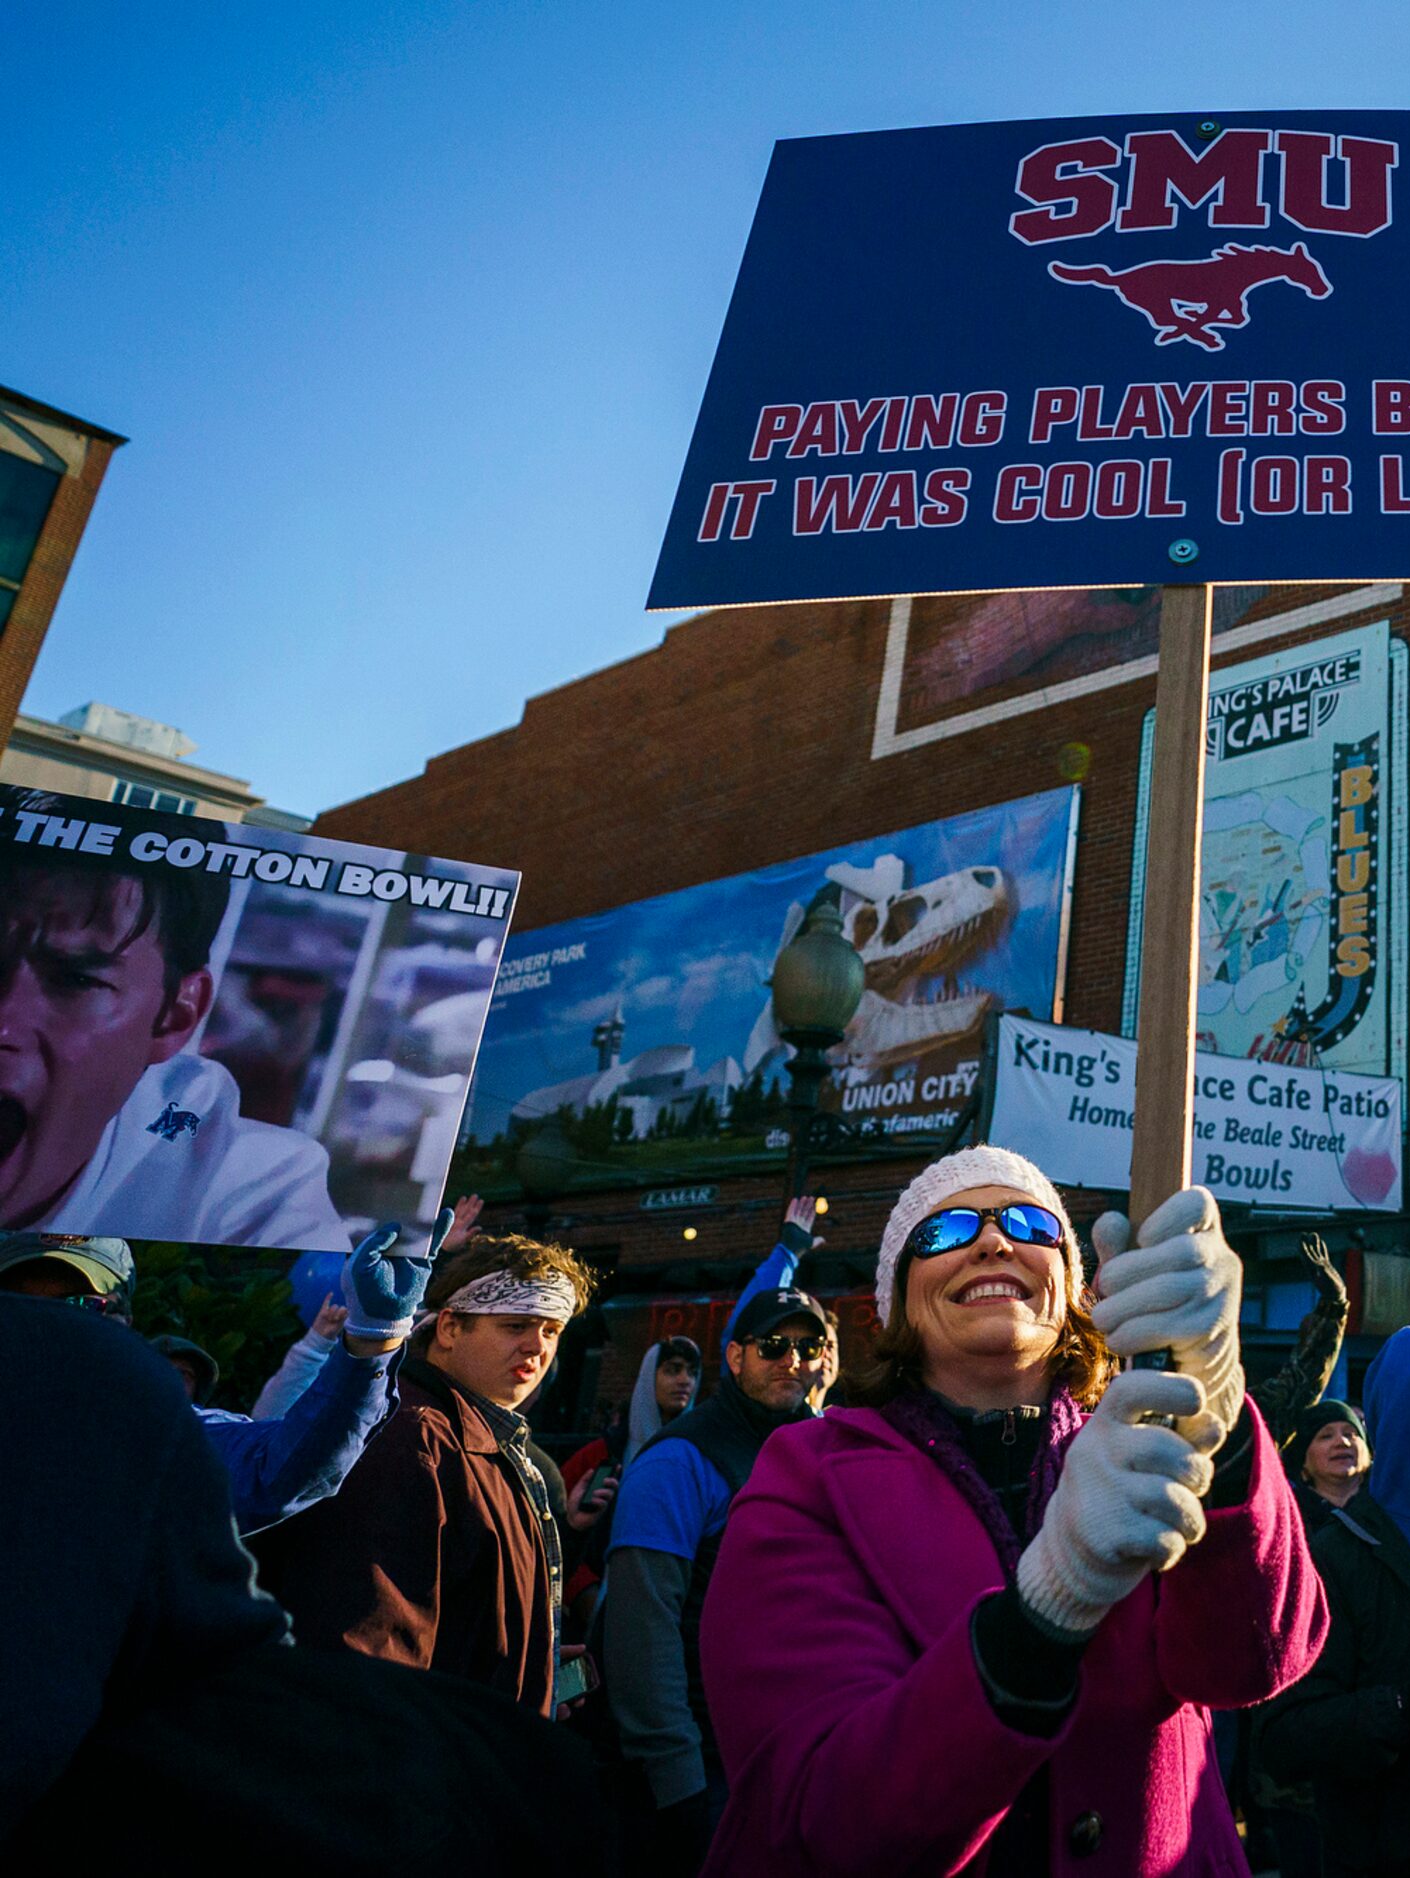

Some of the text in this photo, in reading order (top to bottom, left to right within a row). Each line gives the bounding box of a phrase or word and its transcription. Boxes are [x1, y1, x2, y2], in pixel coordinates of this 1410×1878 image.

[1009, 128, 1400, 245] SMU
[751, 390, 1007, 461] PAYING
[1029, 379, 1347, 444] PLAYERS
[697, 477, 776, 542] IT
[794, 468, 969, 534] WAS
[993, 457, 1186, 525] COOL
[1207, 659, 1347, 719] ING'S PALACE
[1226, 700, 1309, 749] CAFE
[14, 811, 510, 919] THE COTTON BOWL!!
[1334, 765, 1374, 979] BLUES
[551, 942, 586, 966] PARK
[842, 1070, 978, 1112] UNION CITY
[1014, 1034, 1120, 1087] King's
[1247, 1075, 1311, 1110] Cafe
[1321, 1084, 1391, 1120] Patio
[1224, 1117, 1282, 1148] Beale
[1289, 1127, 1345, 1154] Street
[1205, 1154, 1292, 1191] Bowls
